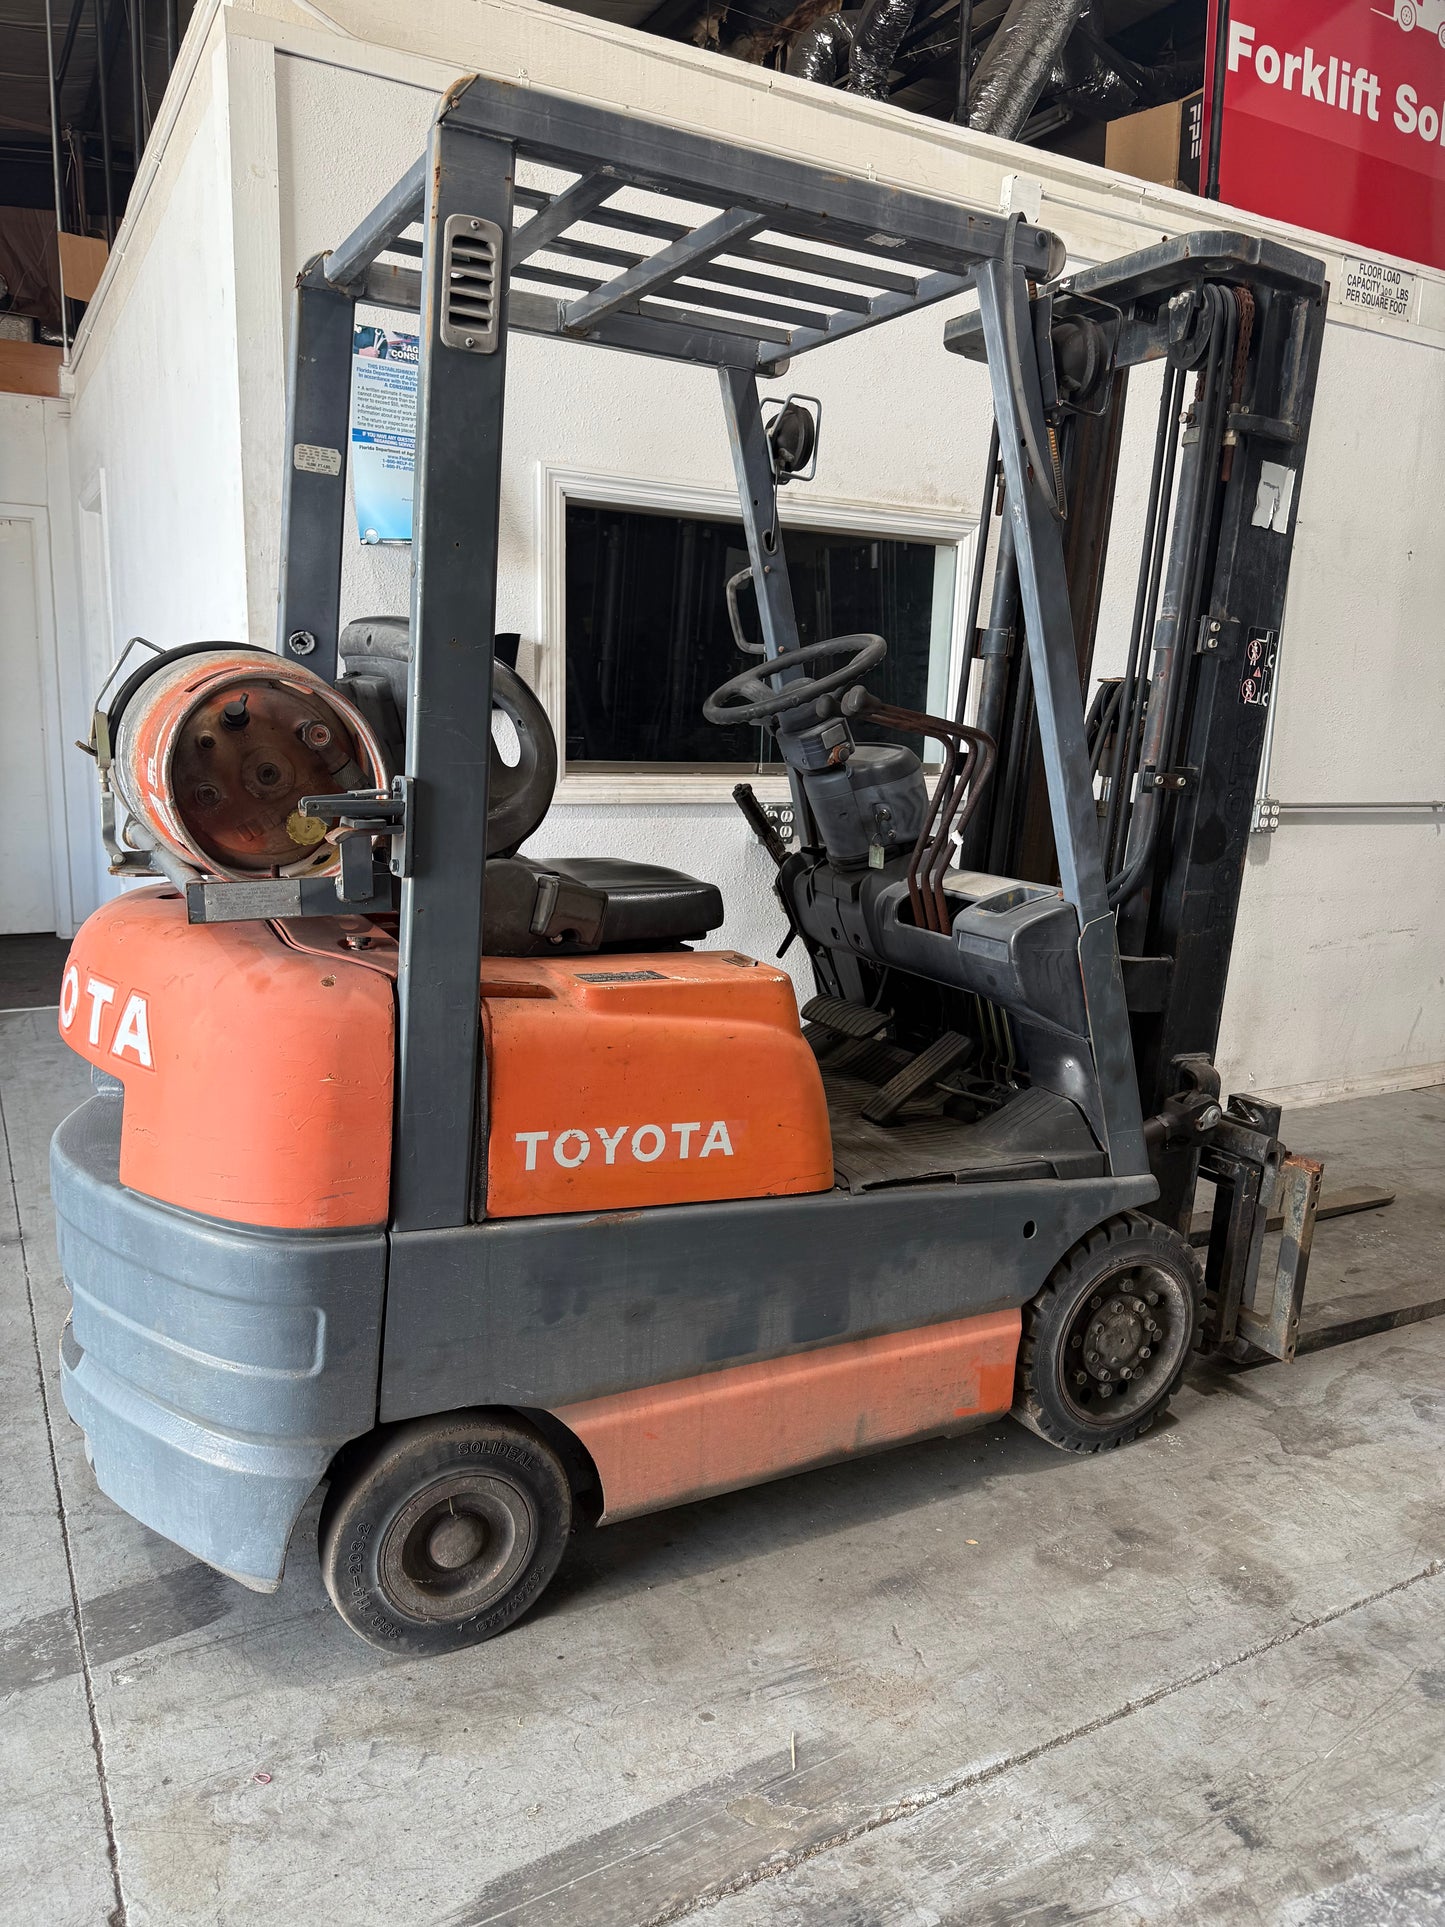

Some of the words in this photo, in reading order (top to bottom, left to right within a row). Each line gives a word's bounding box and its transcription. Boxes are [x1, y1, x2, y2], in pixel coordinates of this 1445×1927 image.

[1228, 20, 1381, 122] Forklift
[1360, 263, 1382, 280] FLOOR
[1383, 270, 1400, 284] LOAD
[1347, 274, 1381, 293] CAPACITY
[1396, 288, 1409, 301] LBS
[1346, 288, 1360, 302] PER
[1362, 292, 1388, 310] SQUARE
[1389, 300, 1407, 314] FOOT
[373, 370, 399, 378] Department
[379, 366, 416, 376] ESTABLISHMENT
[389, 384, 416, 392] CONSUMER
[516, 1121, 734, 1170] TOYOTA
[458, 1441, 534, 1472] SOLIDEAL
